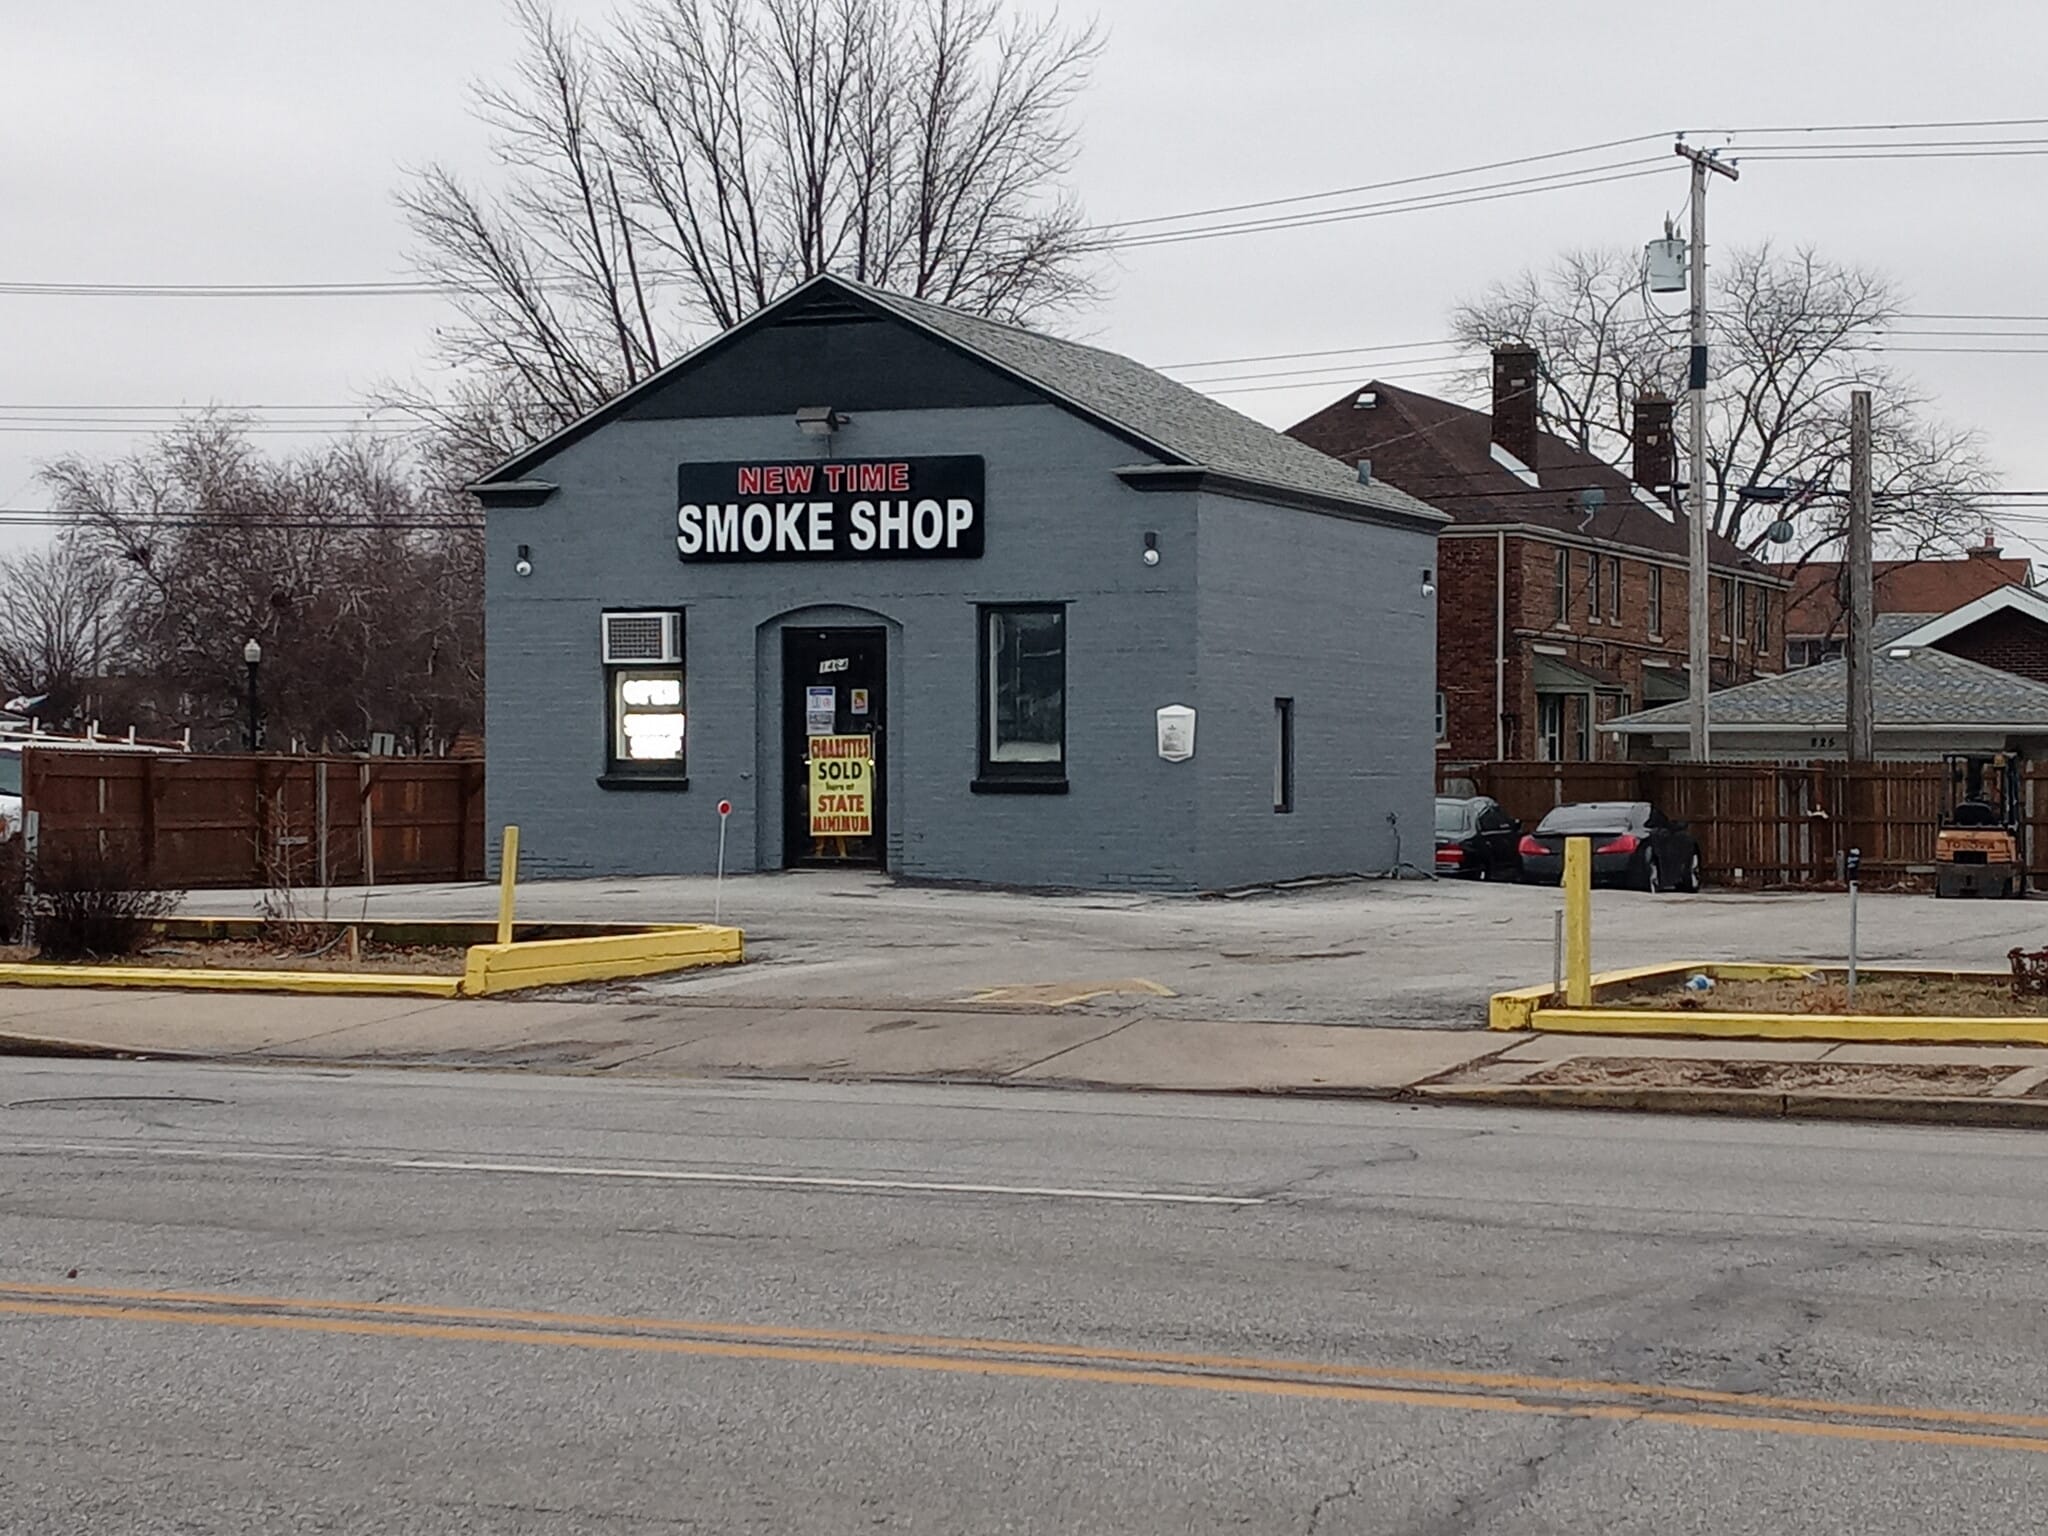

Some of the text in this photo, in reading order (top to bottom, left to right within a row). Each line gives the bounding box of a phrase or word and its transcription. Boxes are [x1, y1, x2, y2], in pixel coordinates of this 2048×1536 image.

[738, 463, 910, 494] NEW TIME
[677, 499, 974, 554] SMOKE SHOP
[818, 761, 862, 780] SOLD
[818, 794, 865, 813] STATE
[813, 816, 870, 832] MINIMUM
